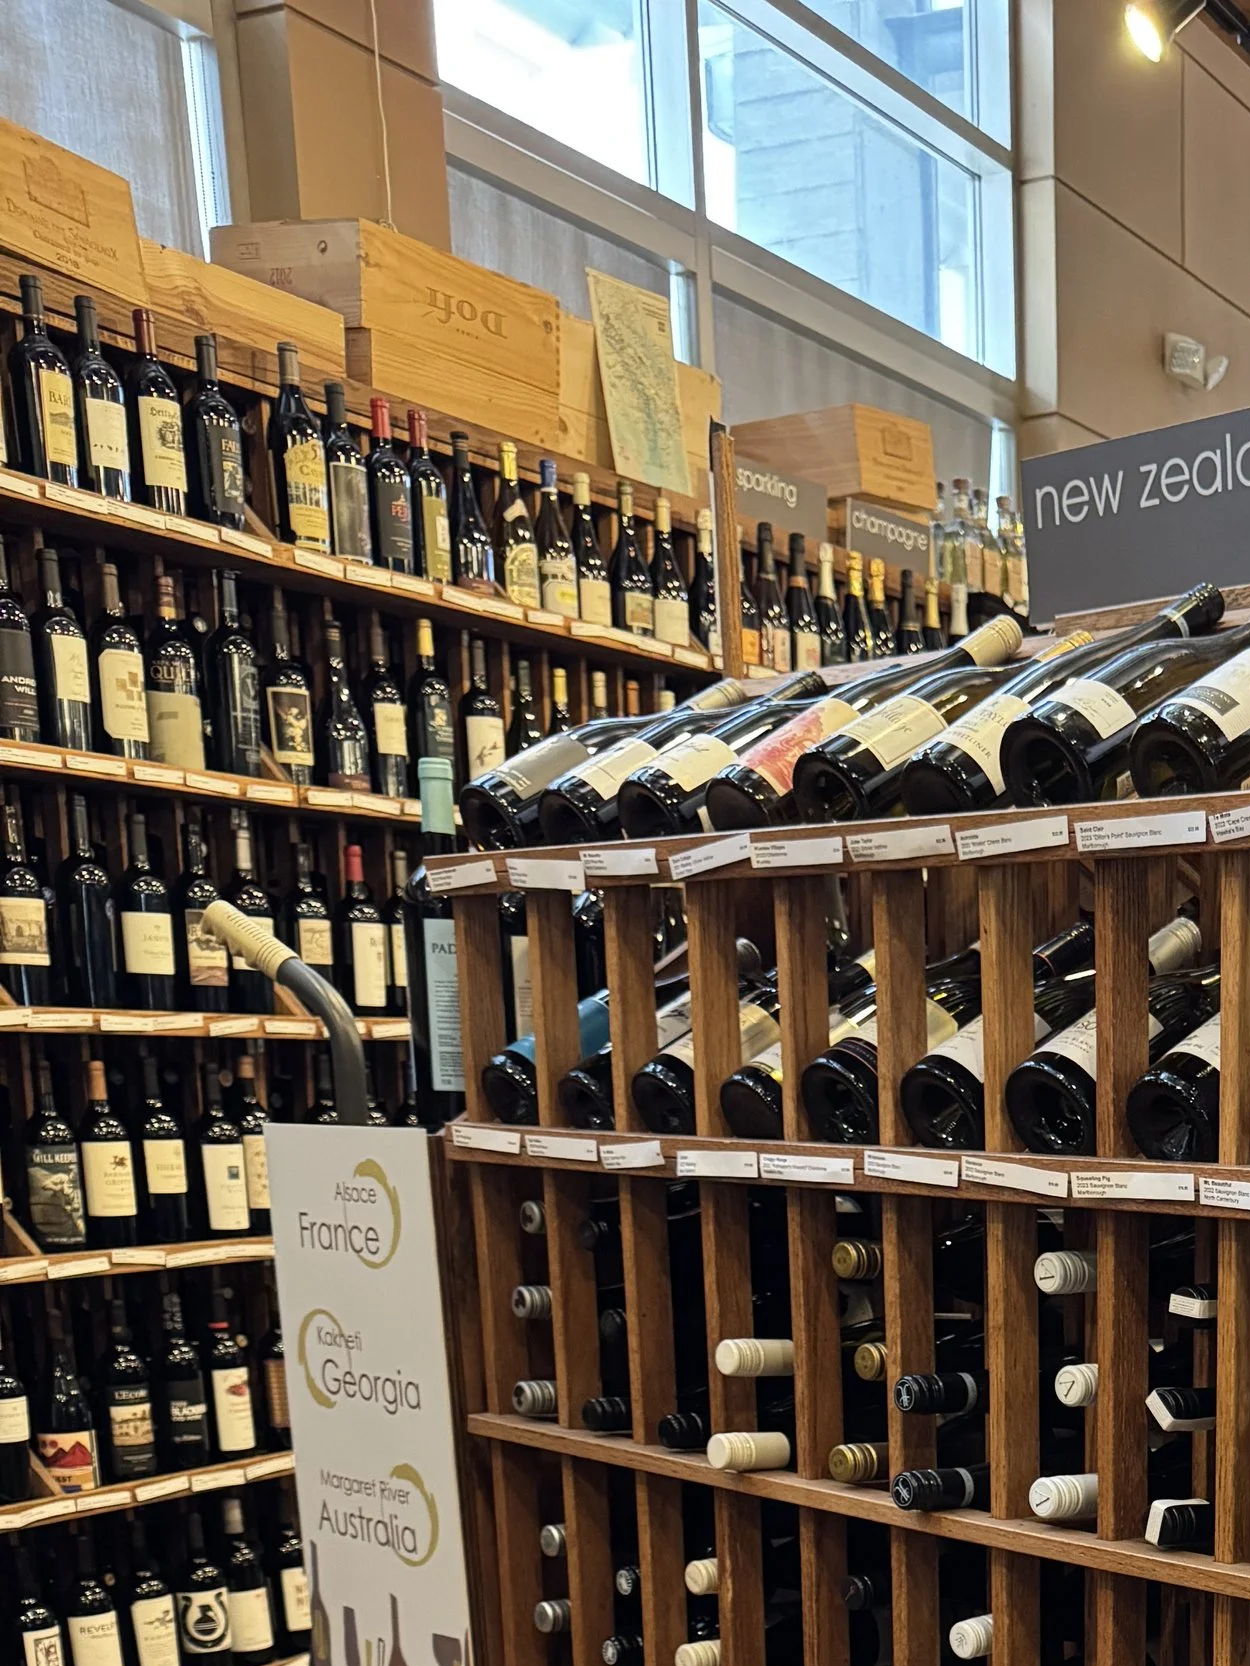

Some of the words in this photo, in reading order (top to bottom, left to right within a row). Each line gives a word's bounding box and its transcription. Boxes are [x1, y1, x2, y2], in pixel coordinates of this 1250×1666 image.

[736, 467, 798, 509] sparkling
[1035, 469, 1124, 530] new
[851, 508, 928, 551] champagne
[1125, 830, 1148, 839] Sauvignon
[1148, 829, 1162, 837] Blanc
[334, 1181, 378, 1205] Alsace
[1214, 1188, 1238, 1196] Sauvignon
[1237, 1190, 1250, 1198] Blanc
[1216, 1195, 1240, 1204] Canterbury
[298, 1211, 381, 1257] France
[316, 1325, 363, 1352] Kakheti
[321, 1358, 422, 1416] Georgia
[320, 1468, 377, 1499] Margaret
[379, 1479, 411, 1506] River
[318, 1499, 418, 1556] Australia
